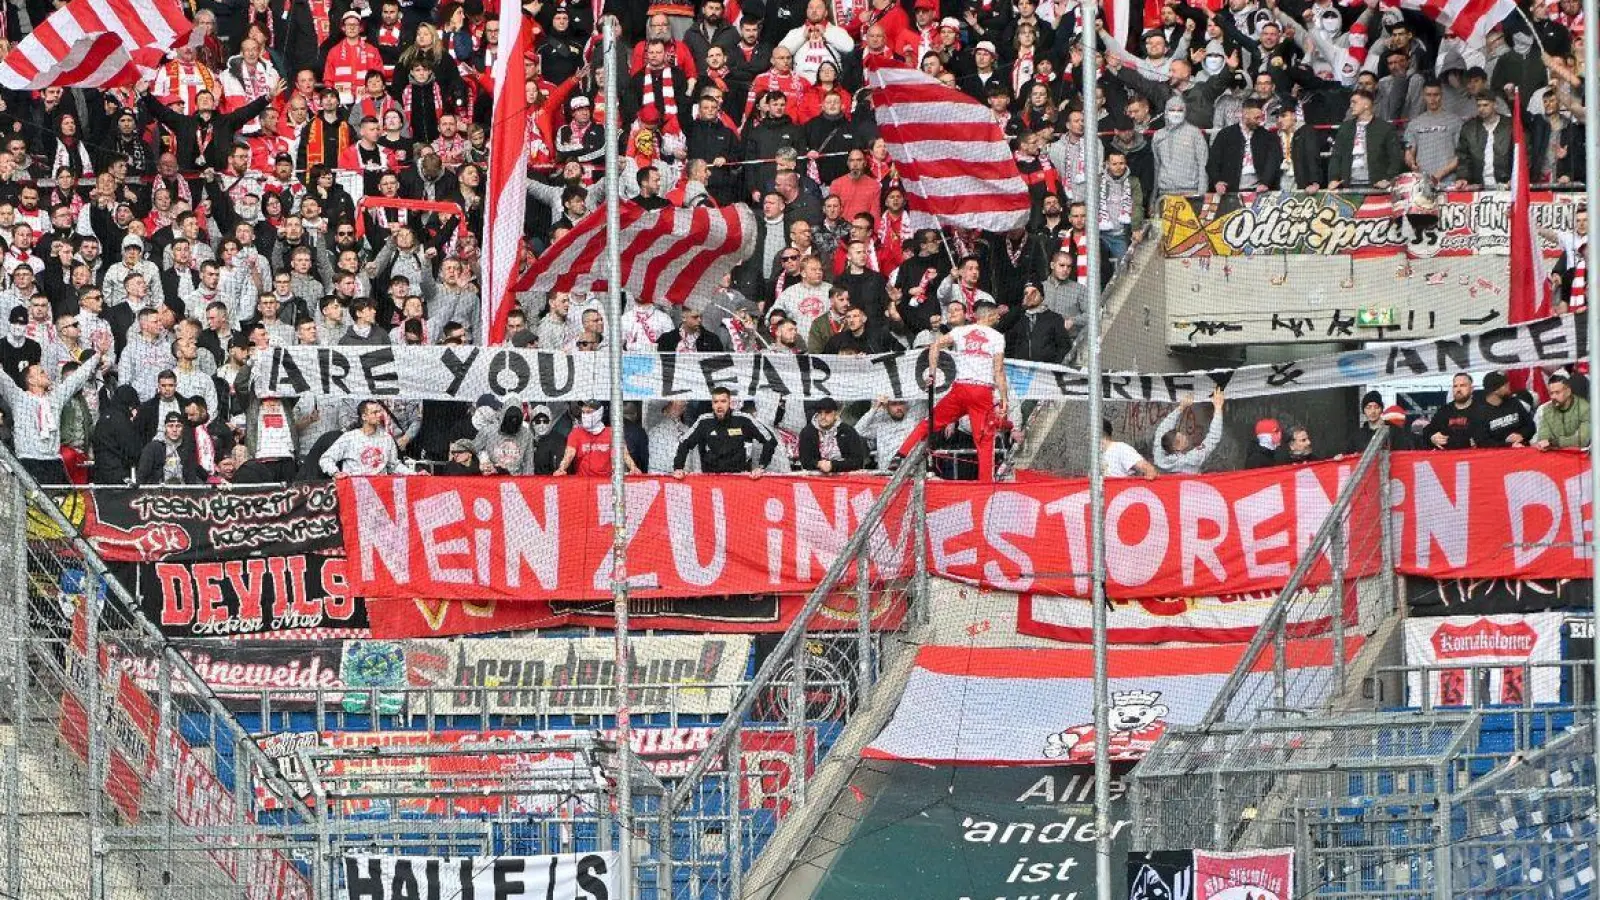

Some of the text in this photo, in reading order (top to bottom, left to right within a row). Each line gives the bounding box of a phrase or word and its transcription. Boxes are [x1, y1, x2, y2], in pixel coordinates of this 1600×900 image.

[1223, 206, 1309, 249] Oder
[268, 348, 399, 395] ARE
[441, 347, 576, 397] YOU
[870, 349, 957, 399] TO
[1267, 361, 1303, 386] &
[131, 495, 208, 520] TEEN
[593, 480, 727, 590] ZU
[155, 556, 356, 626] DEVILS
[191, 613, 265, 635] Action
[1006, 857, 1078, 883] ist
